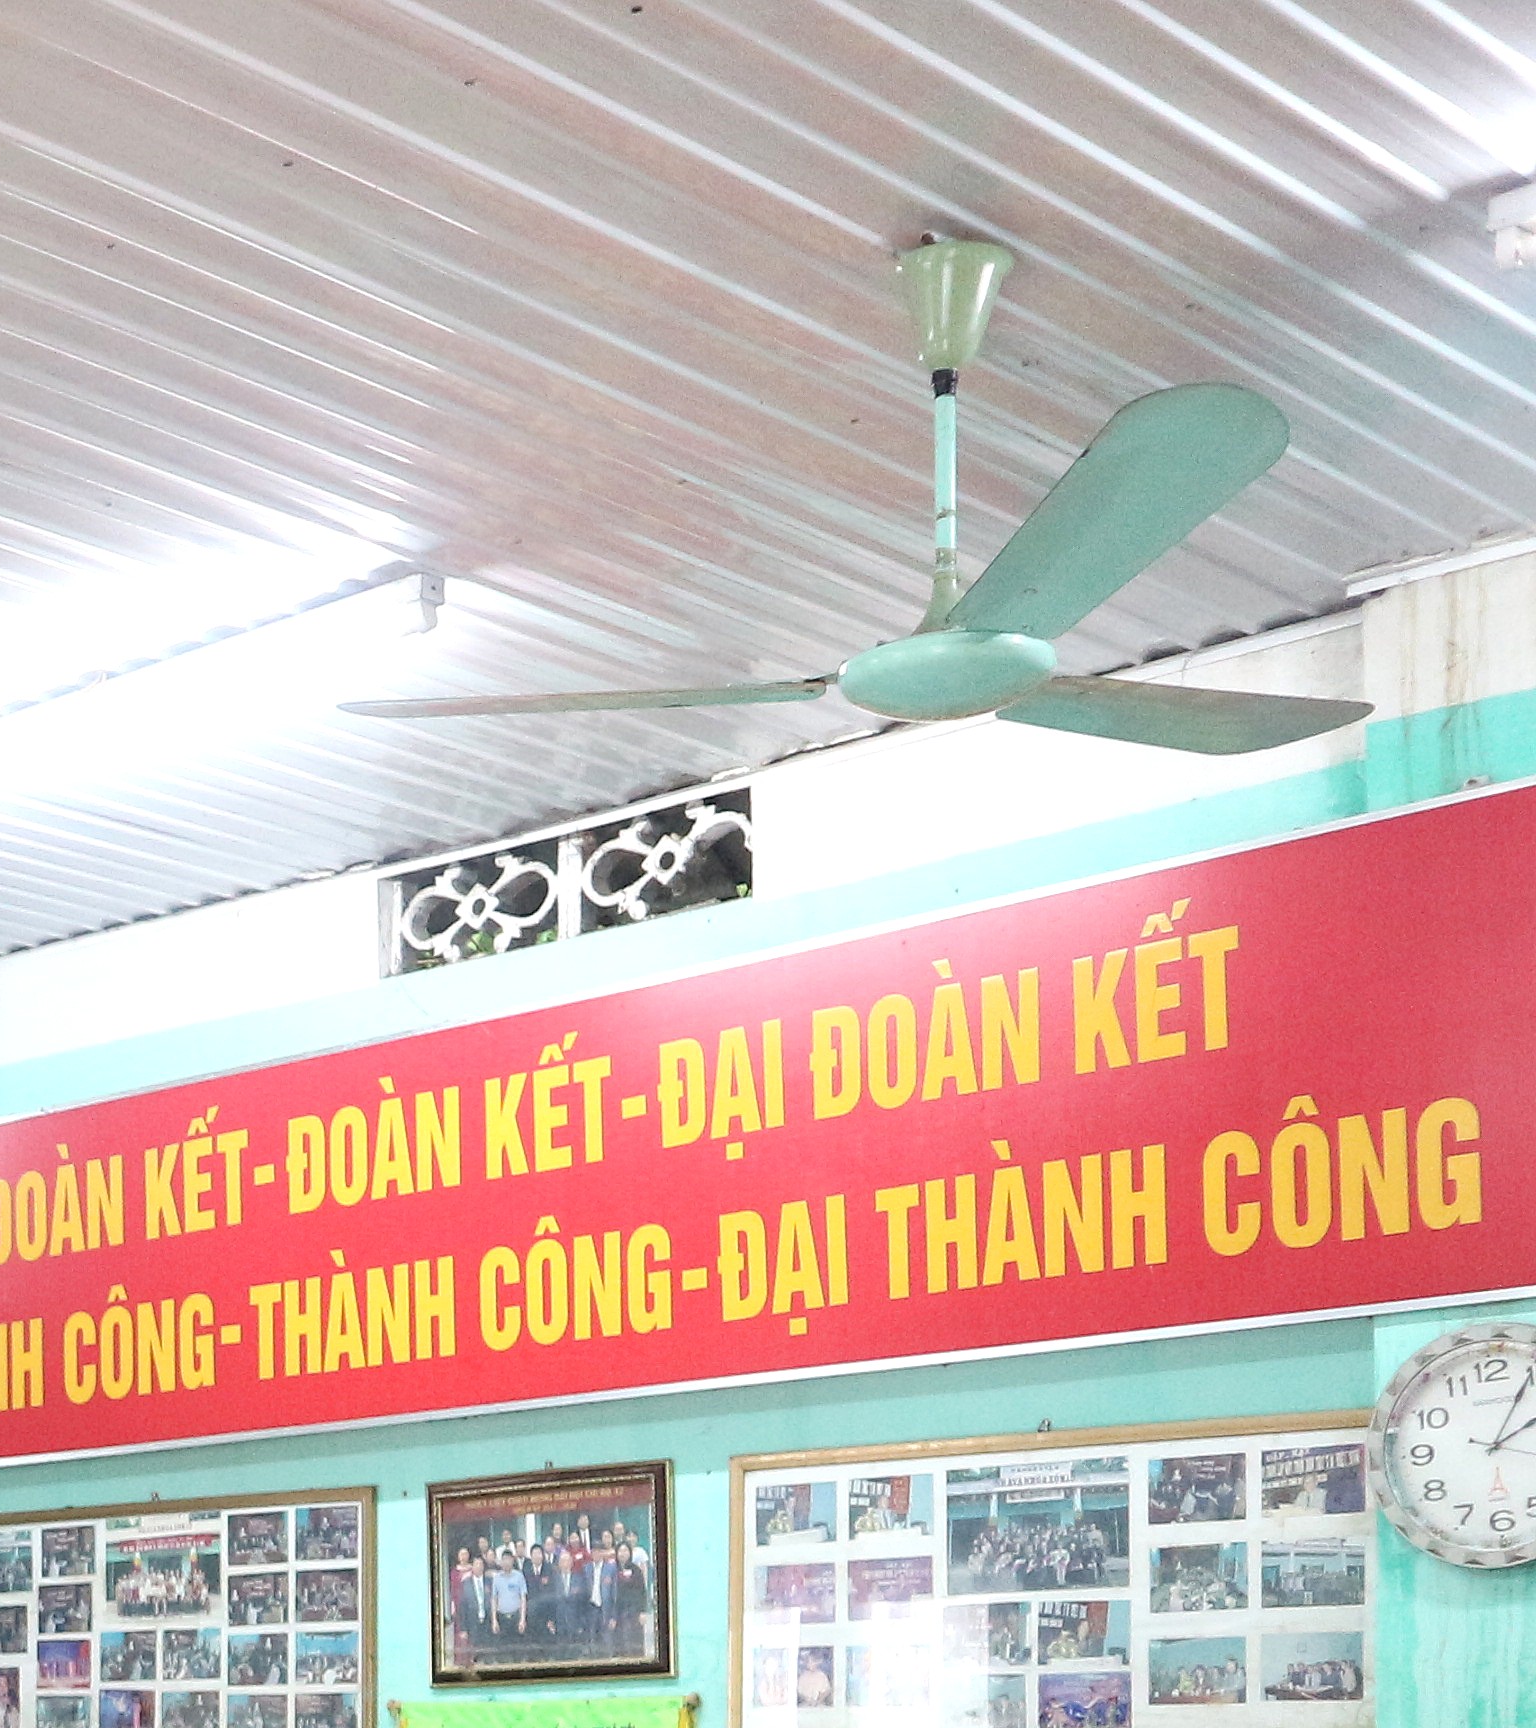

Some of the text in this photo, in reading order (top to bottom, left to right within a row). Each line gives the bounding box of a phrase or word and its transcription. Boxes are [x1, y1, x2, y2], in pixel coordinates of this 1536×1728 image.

[809, 960, 1041, 1121] ĐOÀN
[1073, 897, 1240, 1076] KẾT
[874, 1139, 1169, 1300] THÀNH
[1202, 1094, 1483, 1257] CÔNG
[1474, 1359, 1510, 1384] 12
[1446, 1375, 1468, 1397] 11
[1417, 1407, 1449, 1430] 10
[1410, 1443, 1435, 1467] 9
[1424, 1479, 1447, 1501] 8
[1453, 1503, 1474, 1525] 7
[1489, 1509, 1516, 1532] 6
